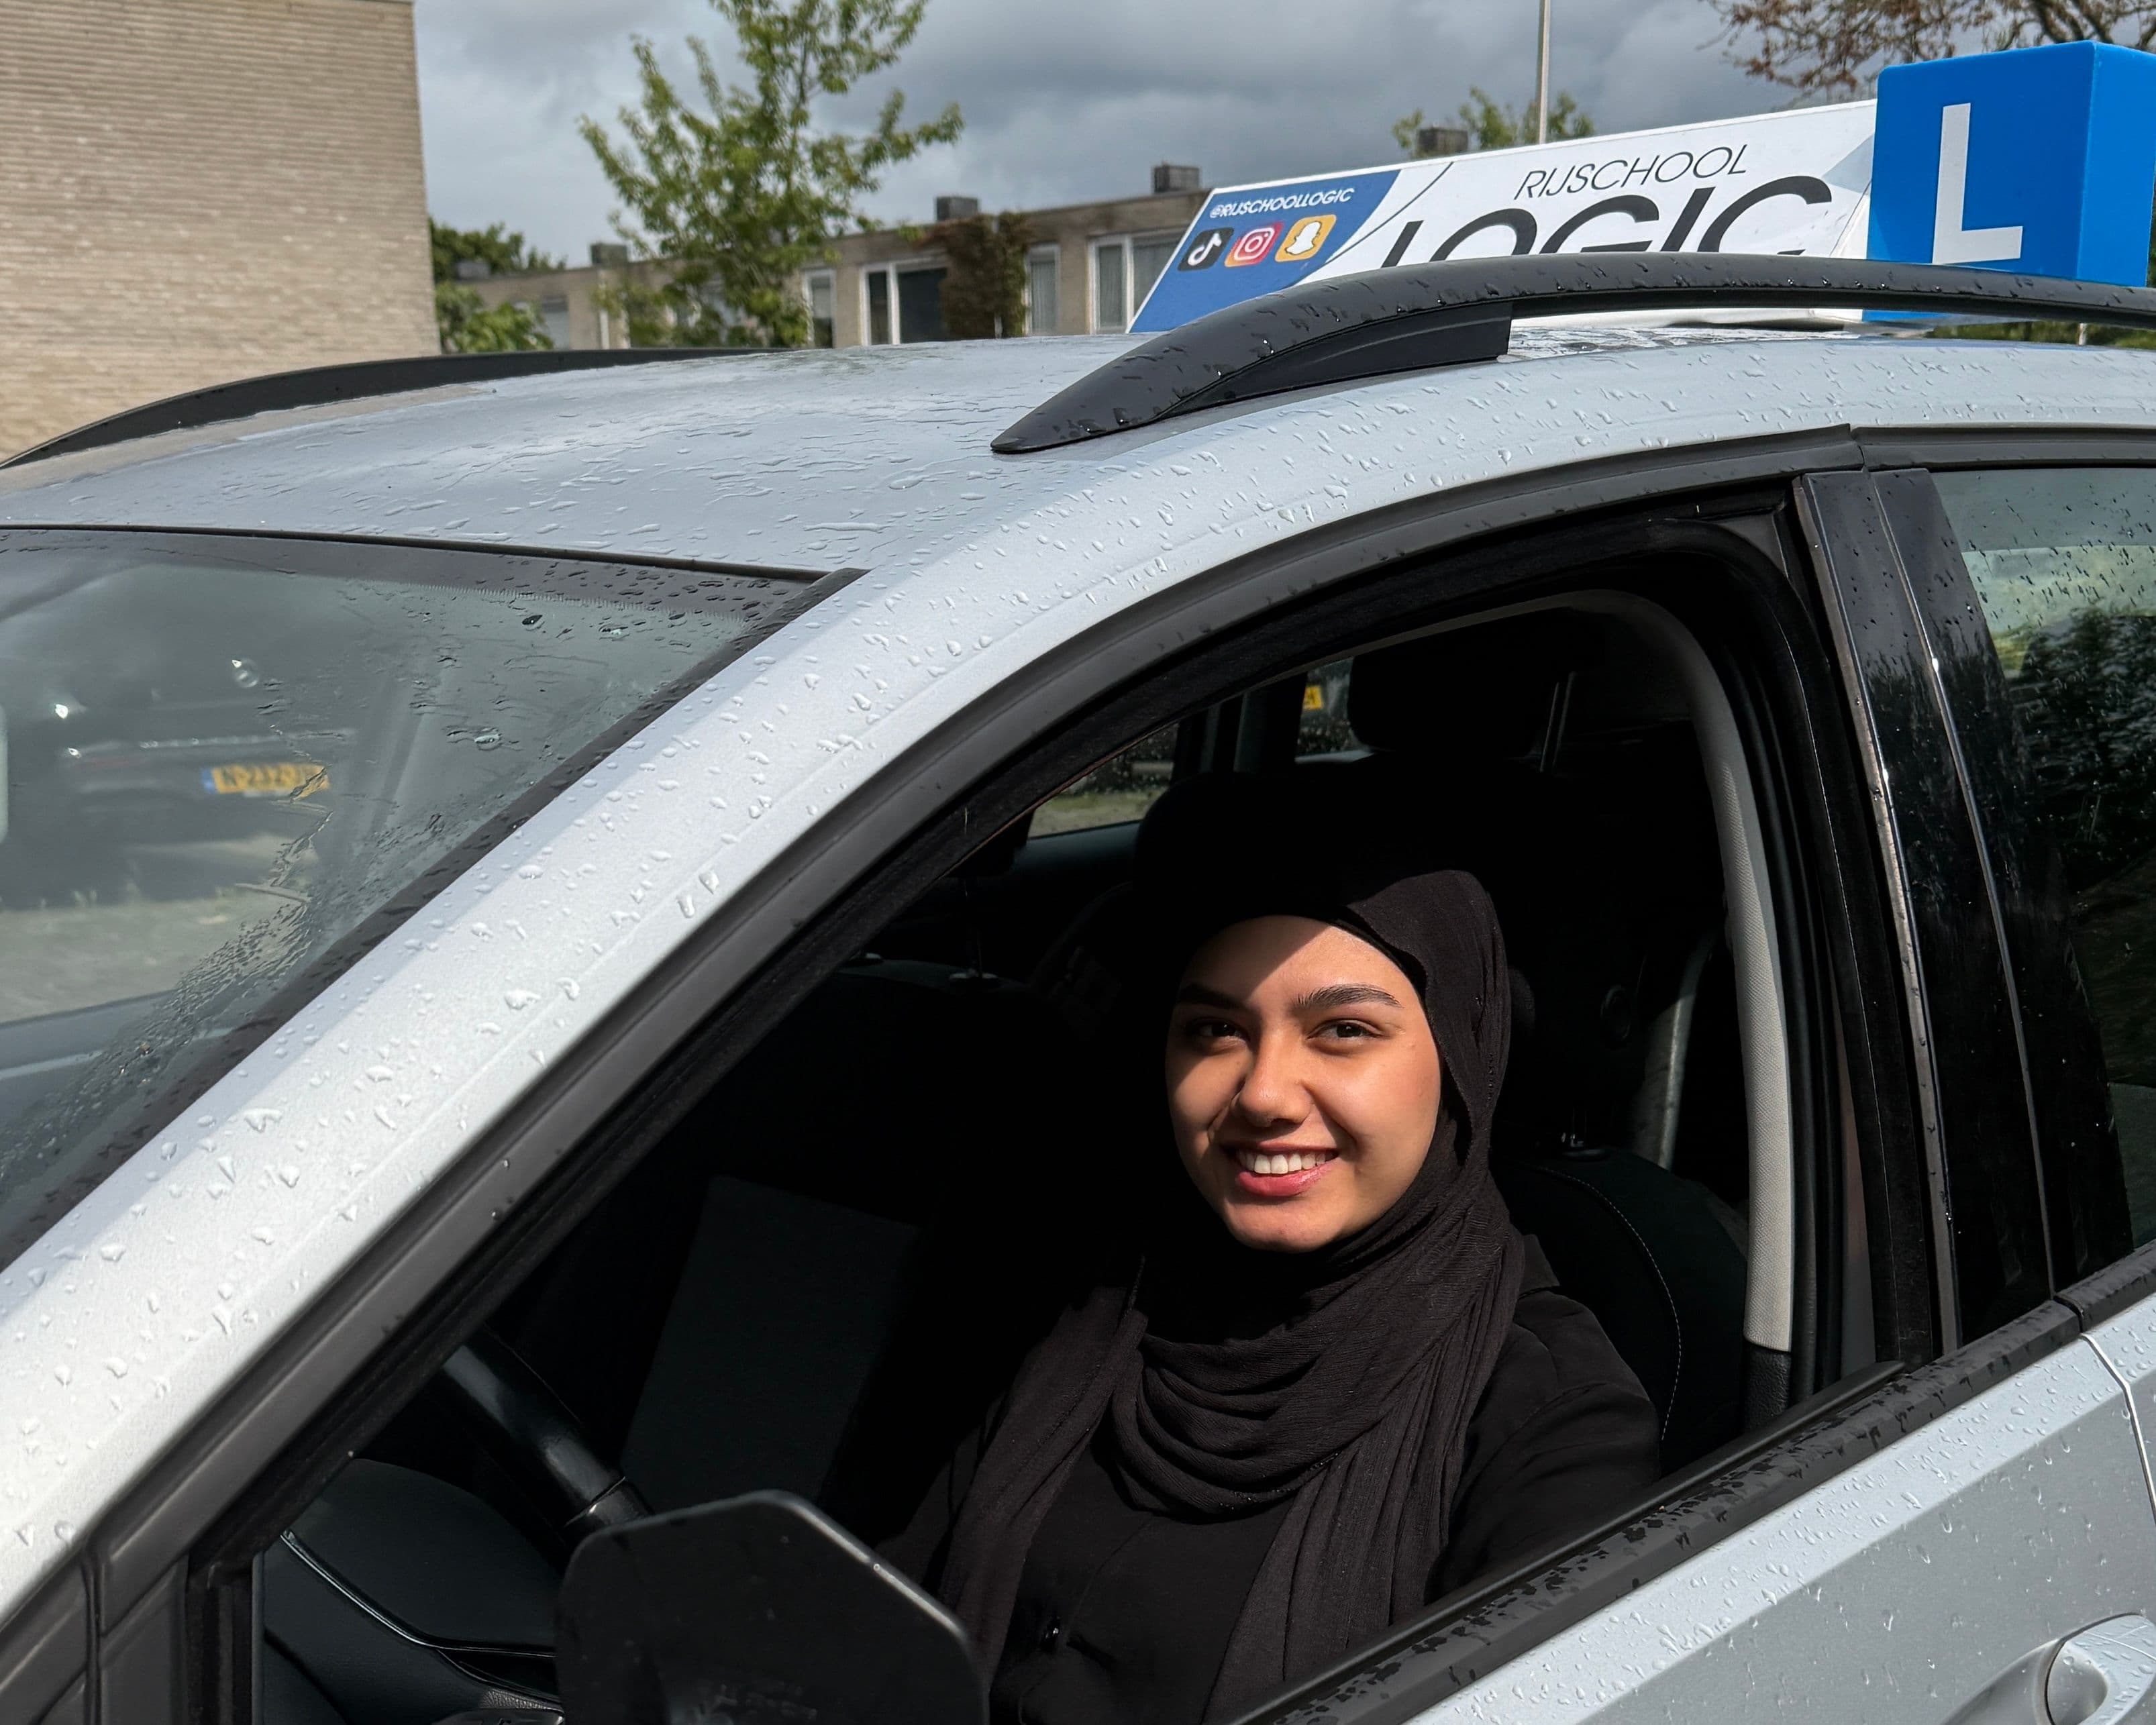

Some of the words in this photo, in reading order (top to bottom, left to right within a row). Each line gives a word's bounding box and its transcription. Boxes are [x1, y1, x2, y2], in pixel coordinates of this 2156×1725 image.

[1514, 144, 1747, 200] RIJSCHOOL
[1932, 102, 2024, 265] L
[1209, 187, 1355, 219] @RIJSCHOOLLOGIC
